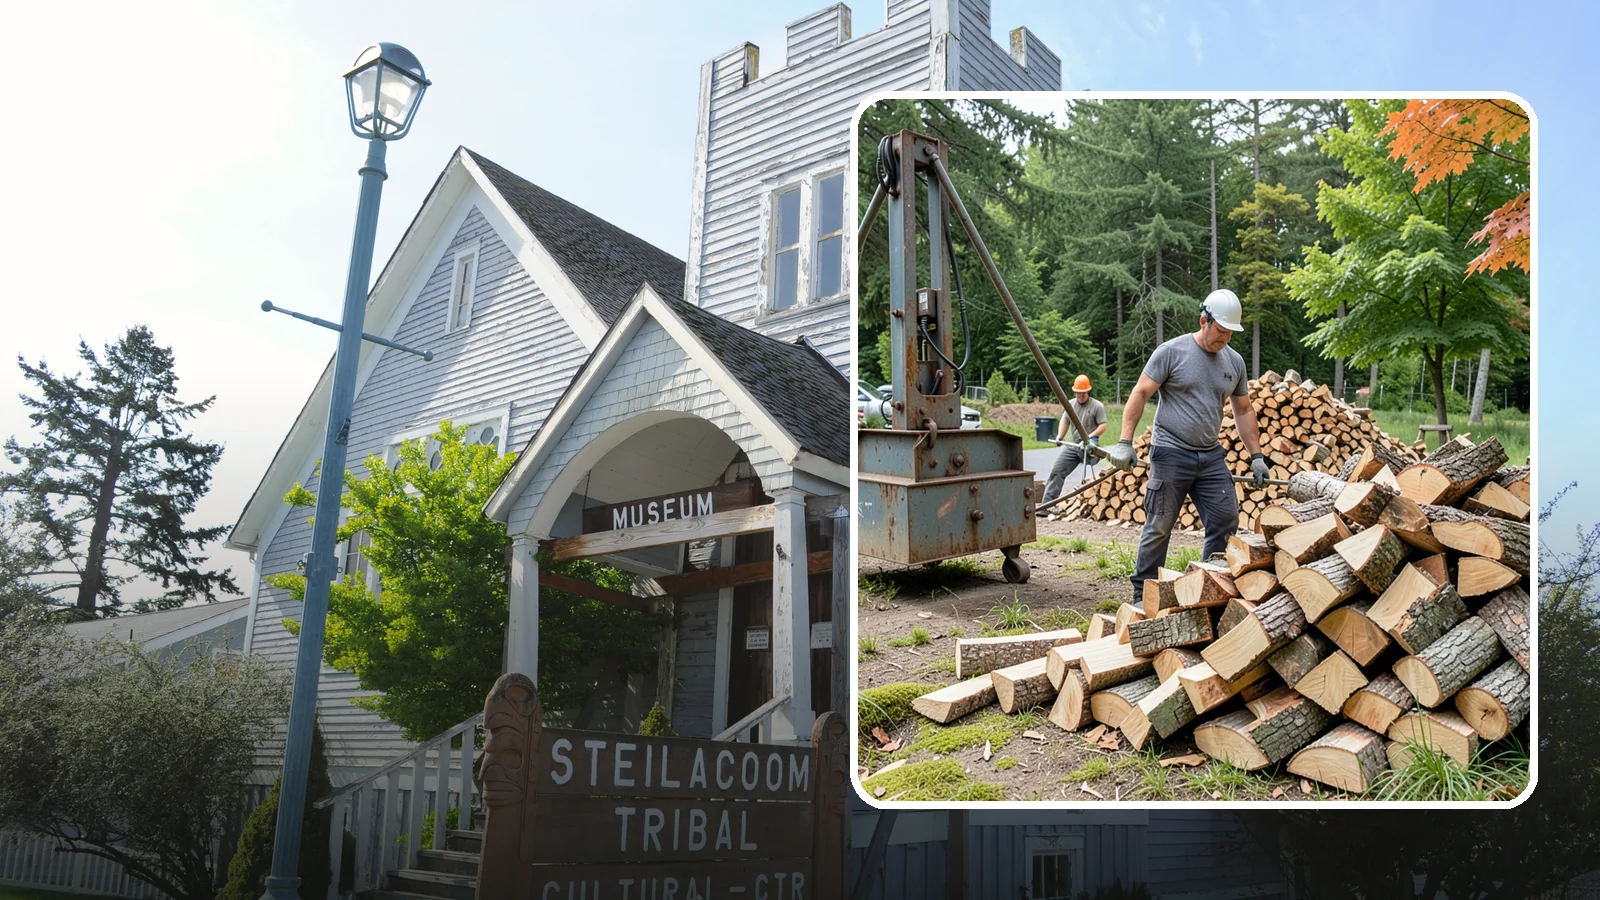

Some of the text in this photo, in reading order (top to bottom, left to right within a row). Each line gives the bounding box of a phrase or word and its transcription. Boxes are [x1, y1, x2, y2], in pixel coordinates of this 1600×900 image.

[612, 491, 714, 531] MUSEUM
[550, 738, 809, 792] STEILACOOM
[615, 807, 757, 851] TRIBAL
